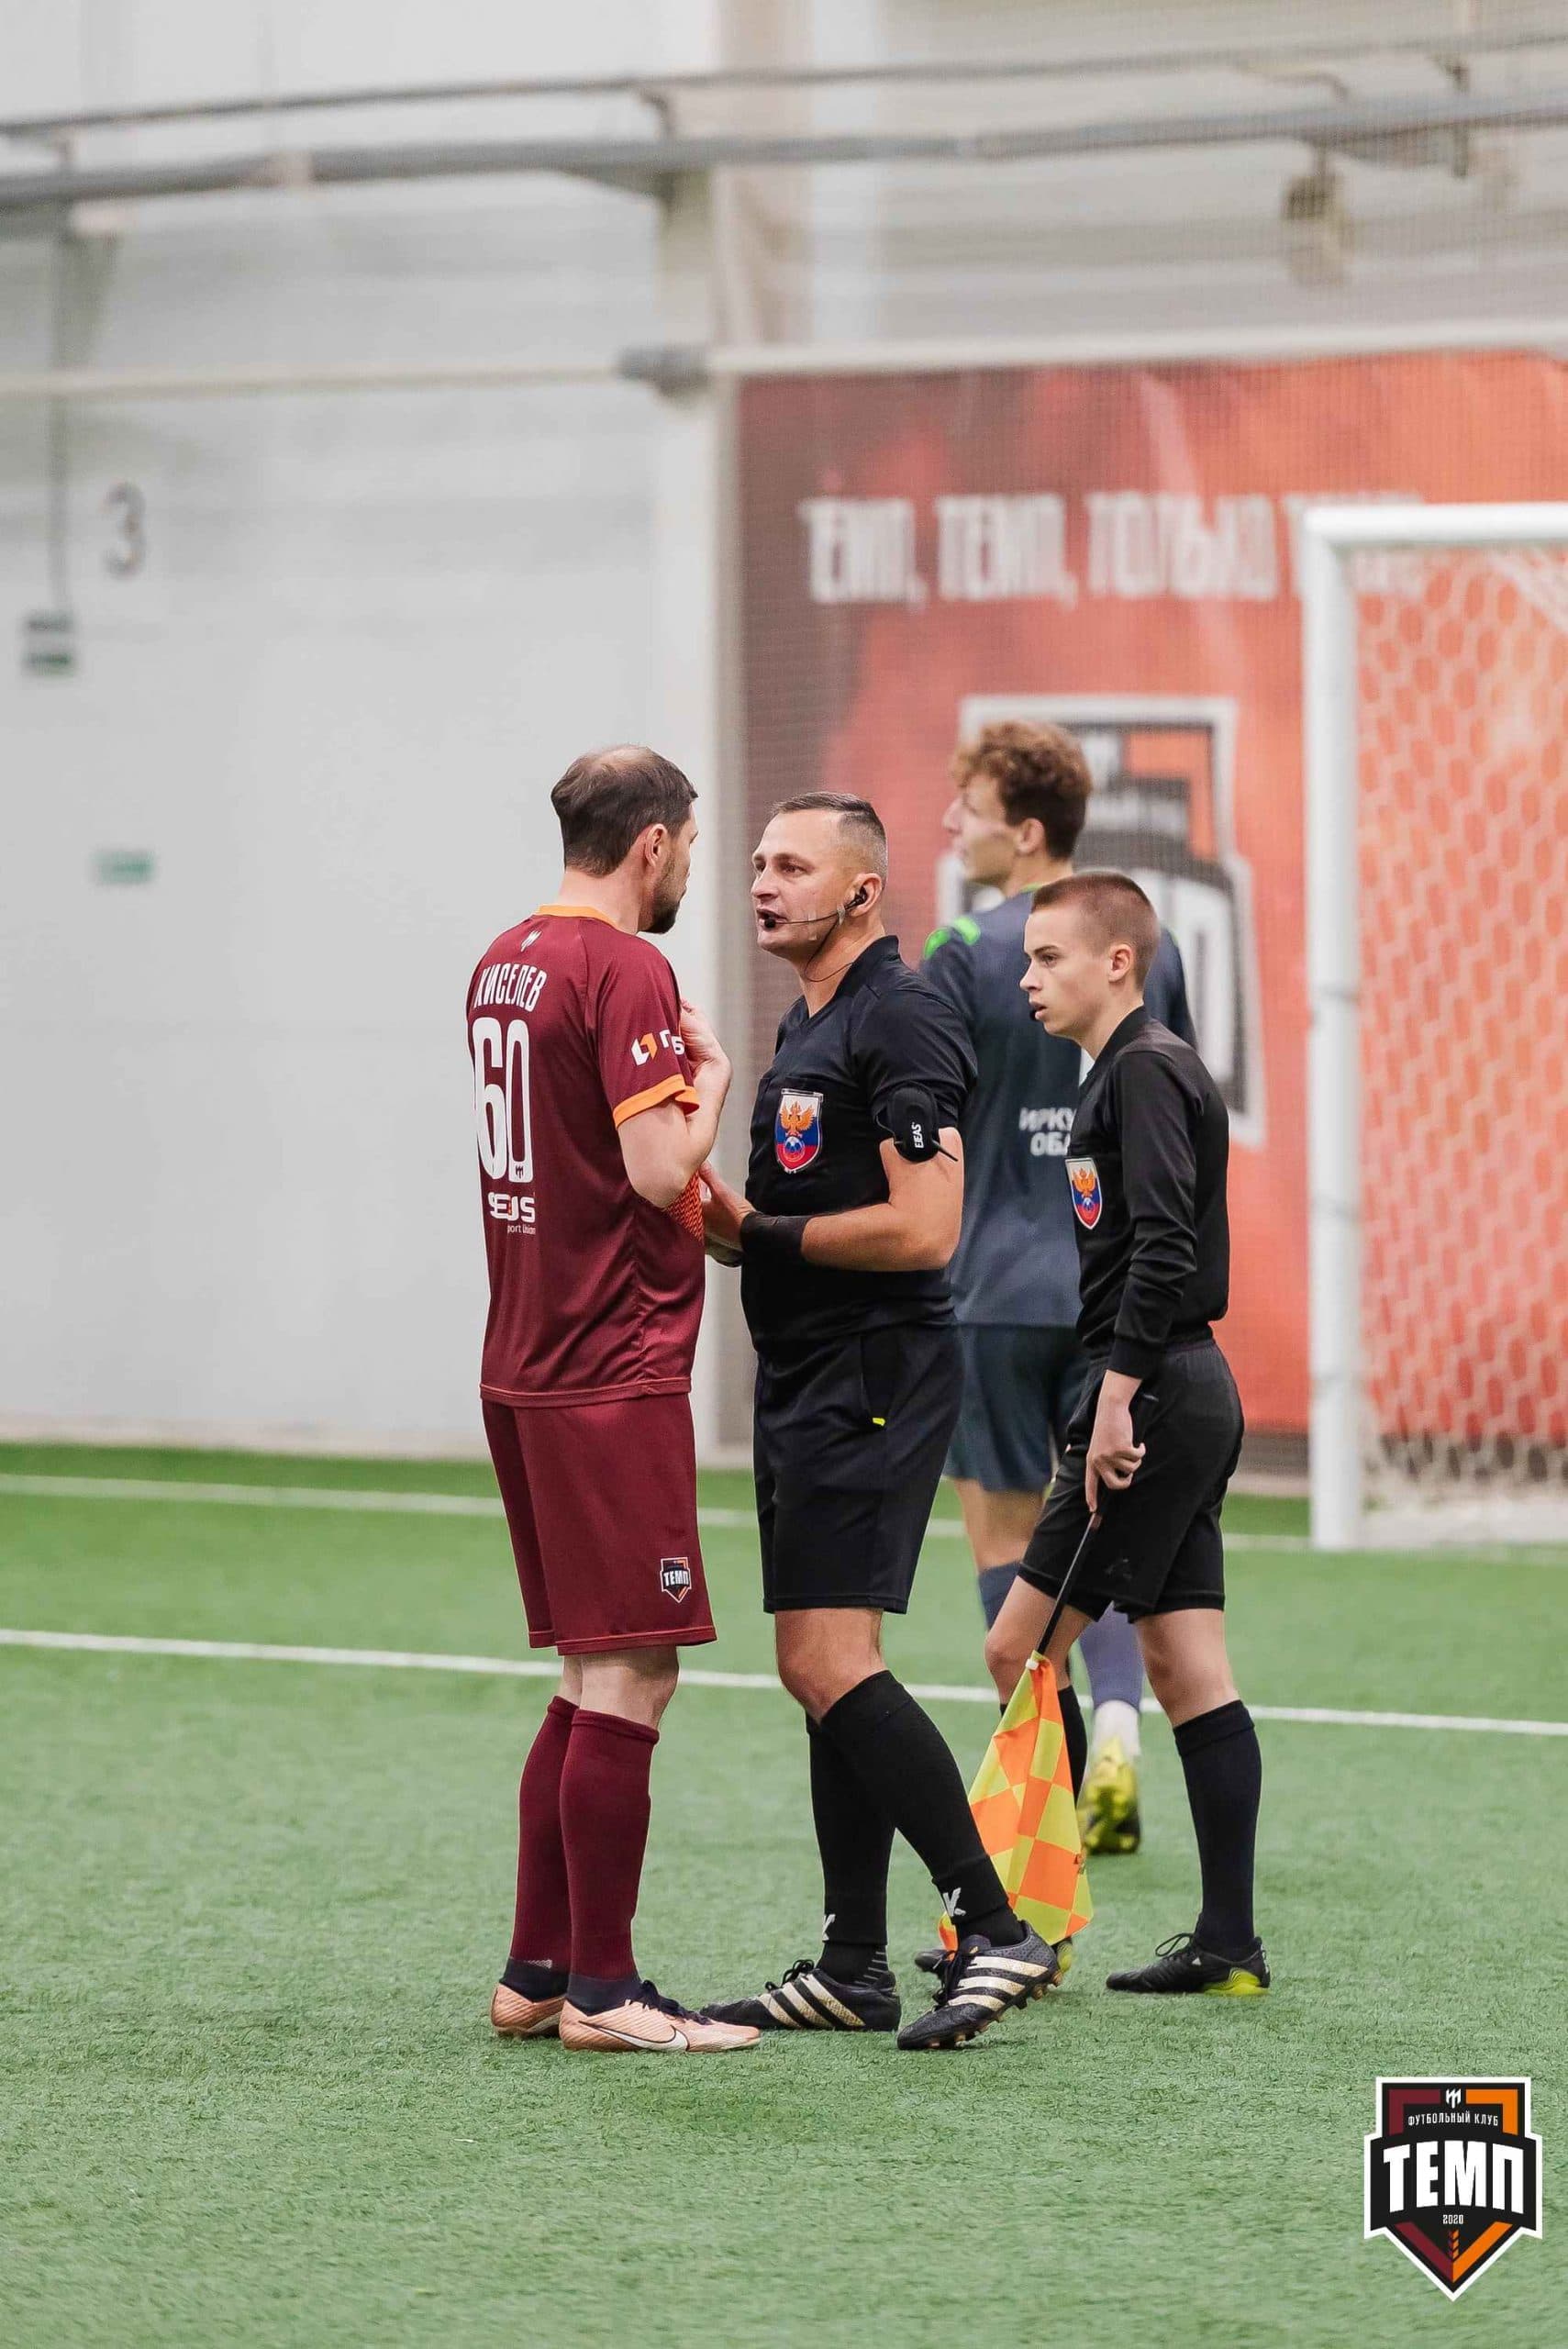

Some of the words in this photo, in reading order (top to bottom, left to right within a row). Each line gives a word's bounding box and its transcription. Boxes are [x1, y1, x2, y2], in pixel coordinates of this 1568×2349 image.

[103, 481, 145, 579] 3
[473, 963, 547, 1012] КИСЕЛЕВ
[473, 1017, 534, 1183] 60
[663, 1570, 689, 1586] ТЕМП
